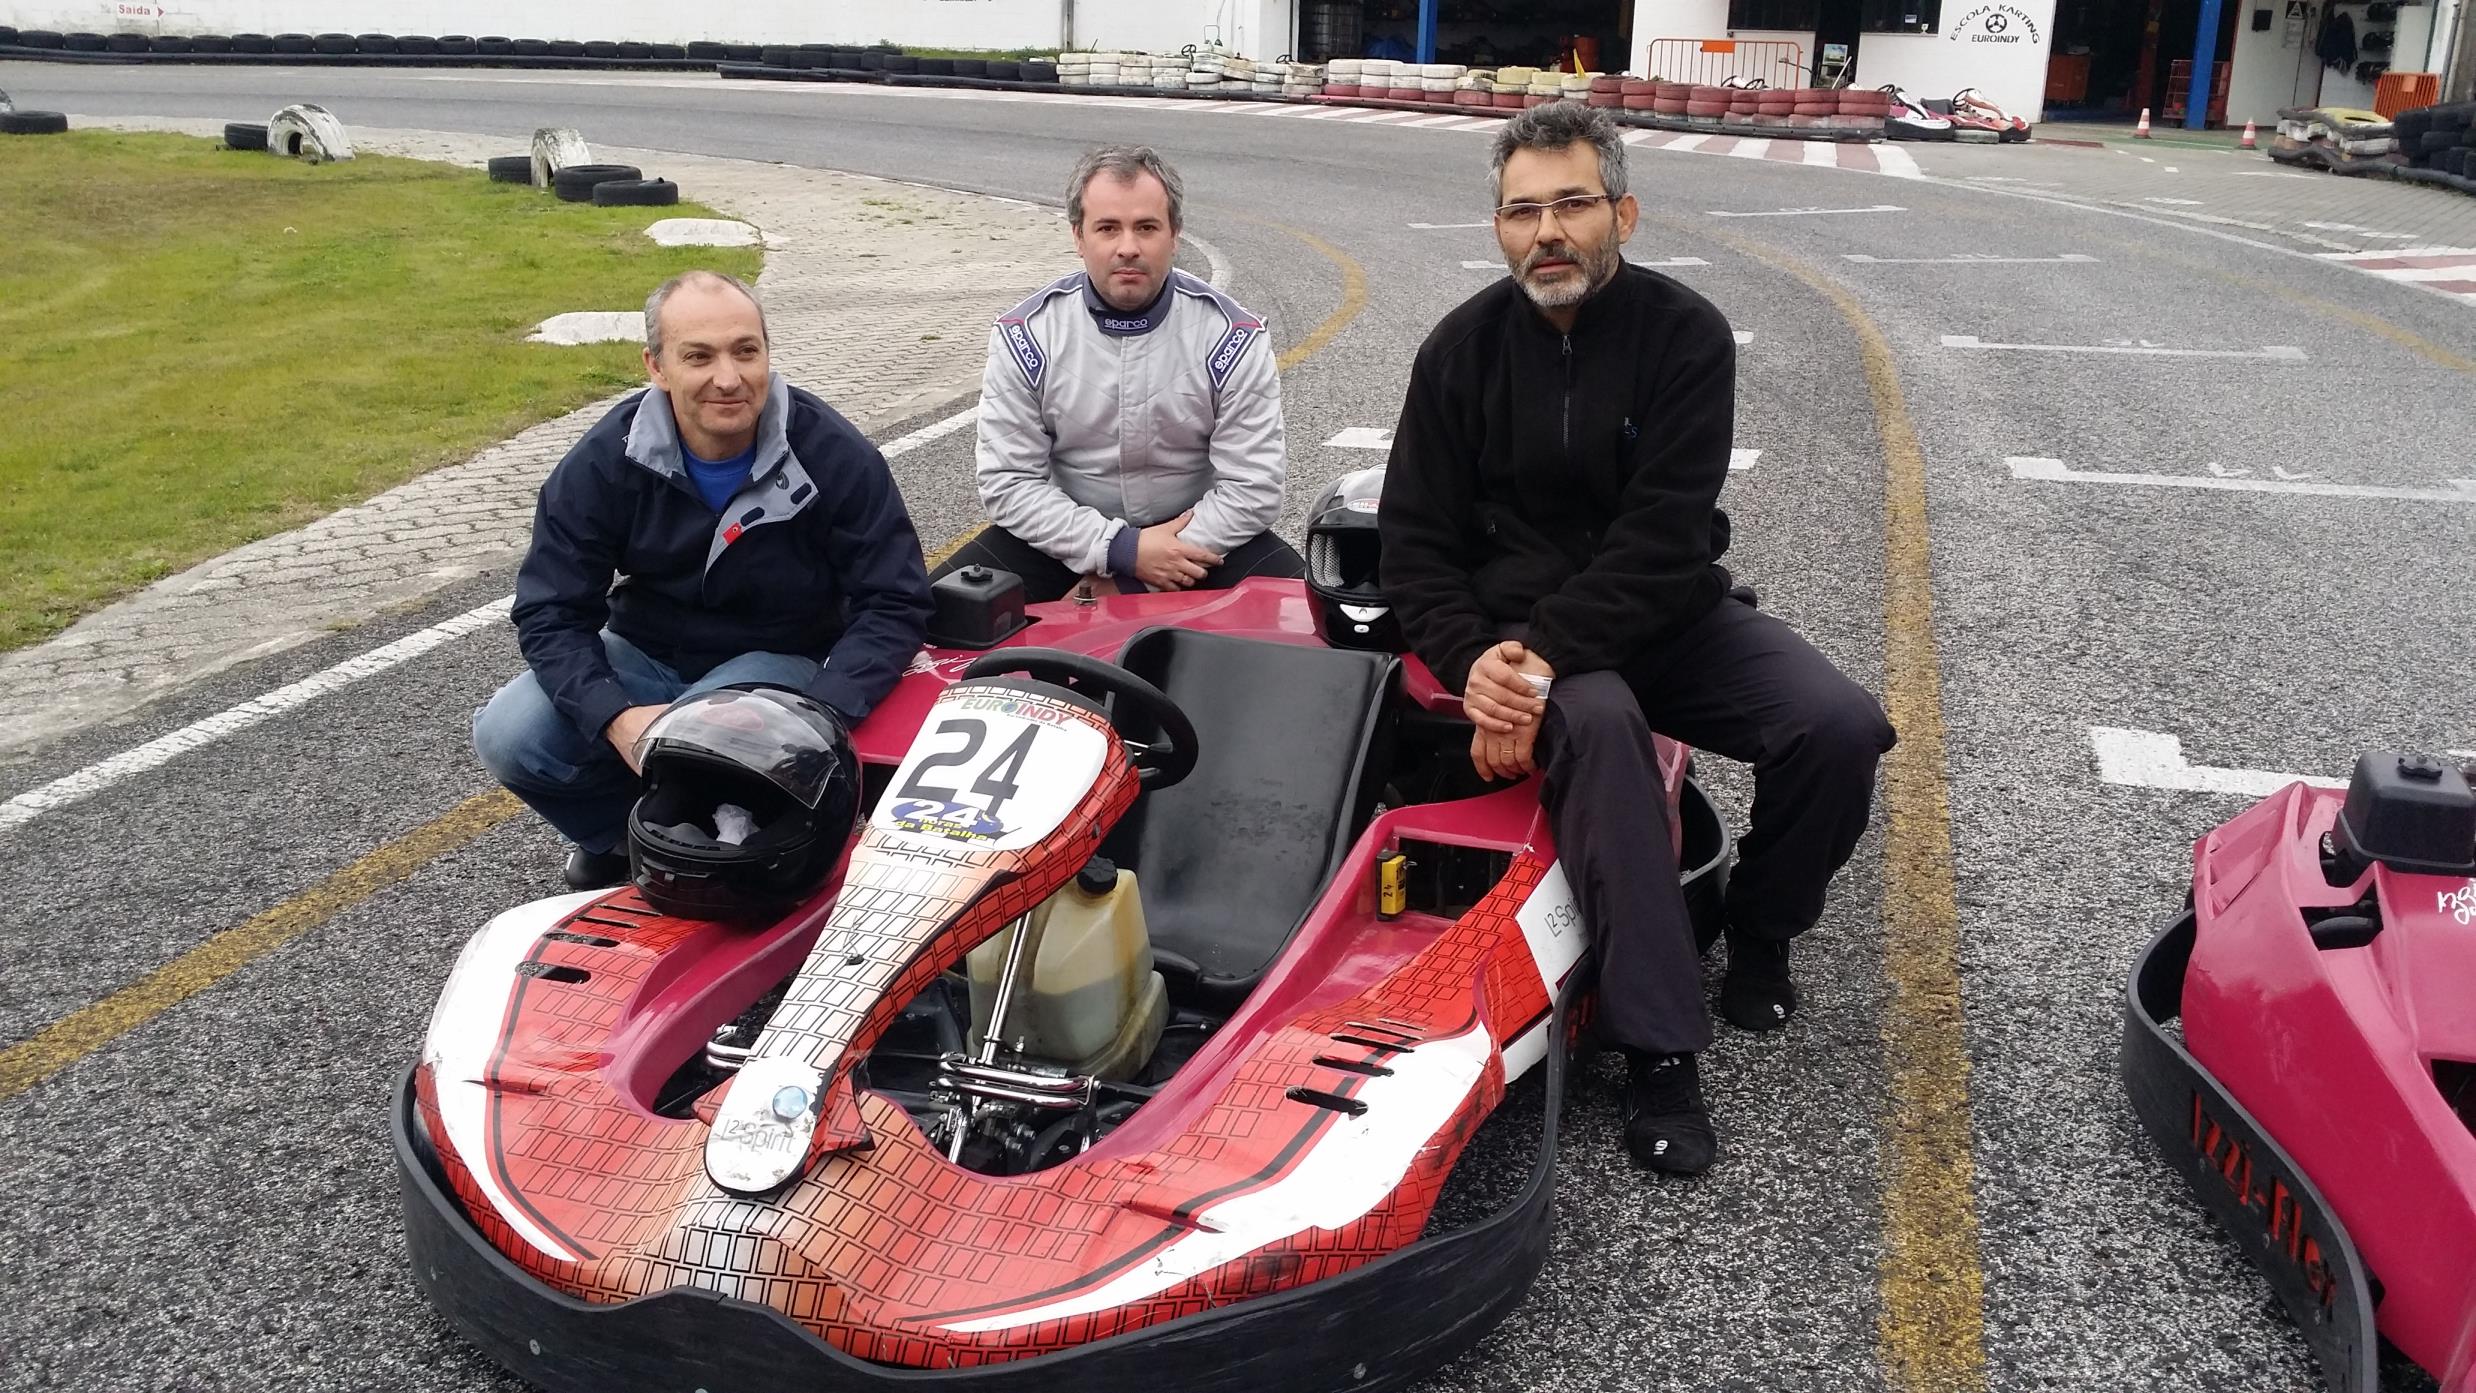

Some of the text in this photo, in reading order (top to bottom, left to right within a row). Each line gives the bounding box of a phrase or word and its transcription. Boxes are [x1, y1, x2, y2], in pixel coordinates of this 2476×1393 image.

[1950, 4, 2040, 44] ESCOLA KARTING
[1971, 34, 2020, 43] EUROINDY
[1104, 318, 1148, 330] sparco
[1009, 324, 1039, 369] sparco
[1214, 328, 1248, 373] sparco
[895, 718, 1041, 818] 24
[920, 823, 988, 841] Batalha
